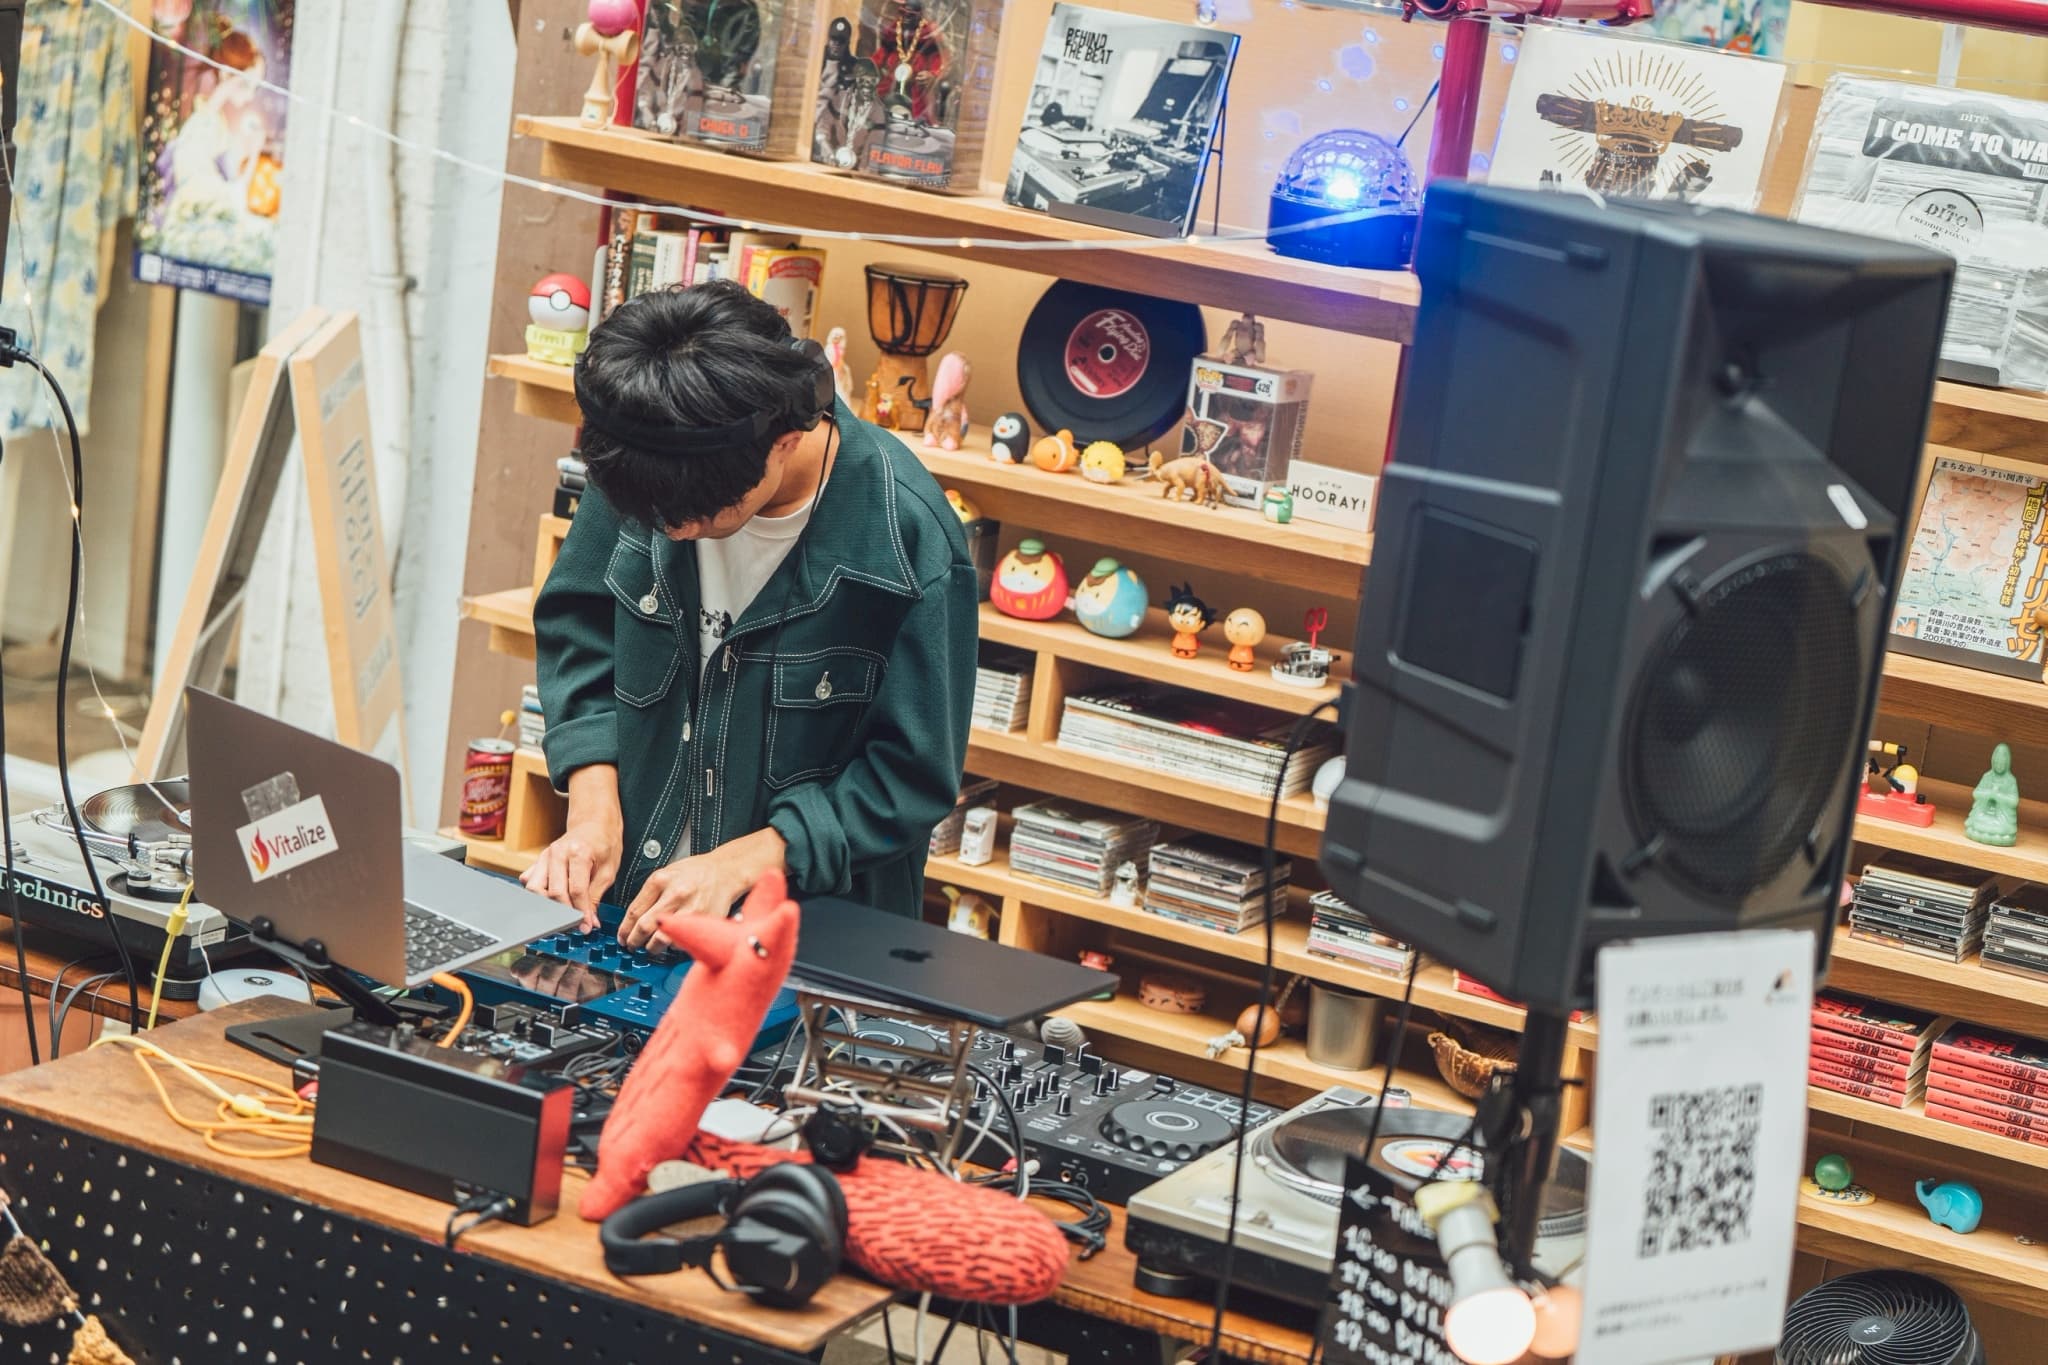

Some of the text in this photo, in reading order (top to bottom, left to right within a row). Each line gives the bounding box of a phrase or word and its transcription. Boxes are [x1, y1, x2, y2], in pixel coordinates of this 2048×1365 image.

[1066, 27, 1108, 49] BEHIND
[1063, 44, 1114, 65] THE BEAT
[700, 117, 736, 136] CHUCK
[1874, 118, 1888, 138] I
[1891, 120, 1964, 150] COME
[1969, 132, 2004, 155] TO
[1941, 460, 1976, 473] まちなか
[1291, 484, 1366, 512] HOORAY!
[267, 824, 327, 859] Vitalize
[1855, 1042, 1880, 1057] BLUES
[2012, 1064, 2038, 1080] BLUES
[2010, 1080, 2036, 1095] BLUES
[2008, 1094, 2033, 1110] BLUES
[2006, 1110, 2032, 1126] BLUES
[2005, 1125, 2031, 1141] BLUES
